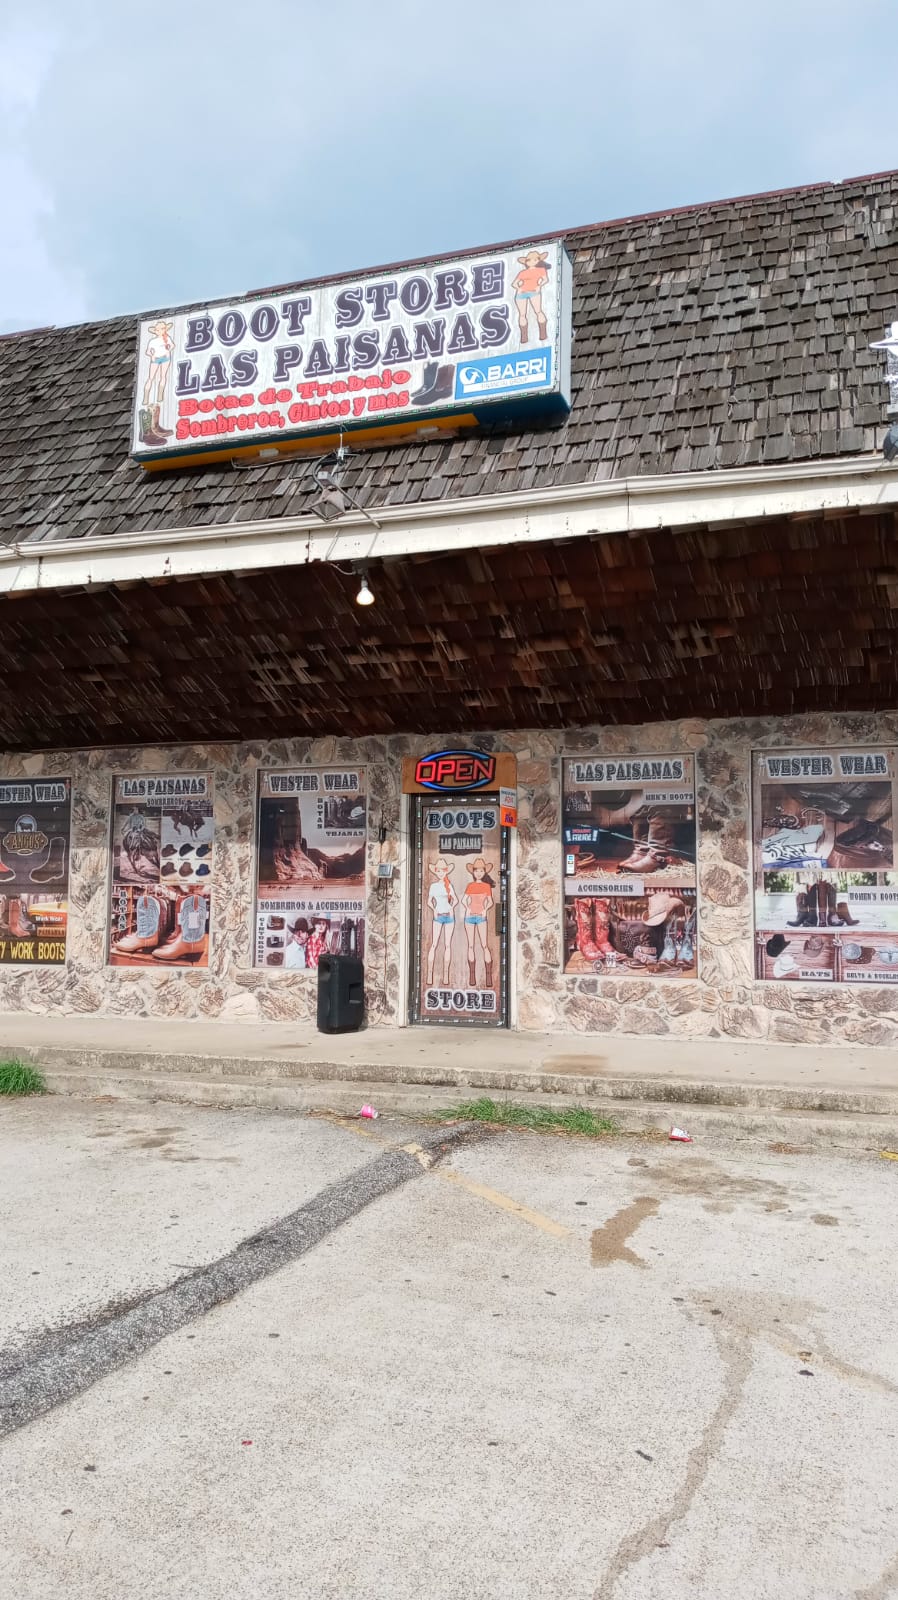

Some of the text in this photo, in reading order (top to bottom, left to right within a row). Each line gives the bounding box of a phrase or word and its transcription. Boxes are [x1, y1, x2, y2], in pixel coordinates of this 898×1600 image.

[185, 260, 504, 353] BOOT STORE
[176, 304, 511, 396] LAS PAISANAS
[487, 357, 547, 384] BARRI
[178, 368, 411, 416] Botas de Trabajo
[176, 390, 410, 440] Sombreros, Cintos y mas
[415, 758, 496, 783] OPEN
[575, 760, 683, 782] LAS PAISANAS
[767, 755, 887, 776] WESTER WEAR
[123, 777, 206, 796] LAS PAISANAS
[269, 773, 359, 792] WESTER WEAR
[35, 784, 66, 802] WEAR
[669, 792, 693, 801] BOOTS
[427, 811, 496, 829] BOOTS
[440, 837, 481, 850] LAS PAISANAS
[577, 884, 634, 892] ACCESSORIES
[849, 892, 877, 901] WOMEN'S
[260, 901, 362, 911] SOMBREROS & ACCESORIOS
[10, 941, 35, 960] WORK
[38, 942, 65, 960] BOOTS
[426, 990, 495, 1010] STORE
